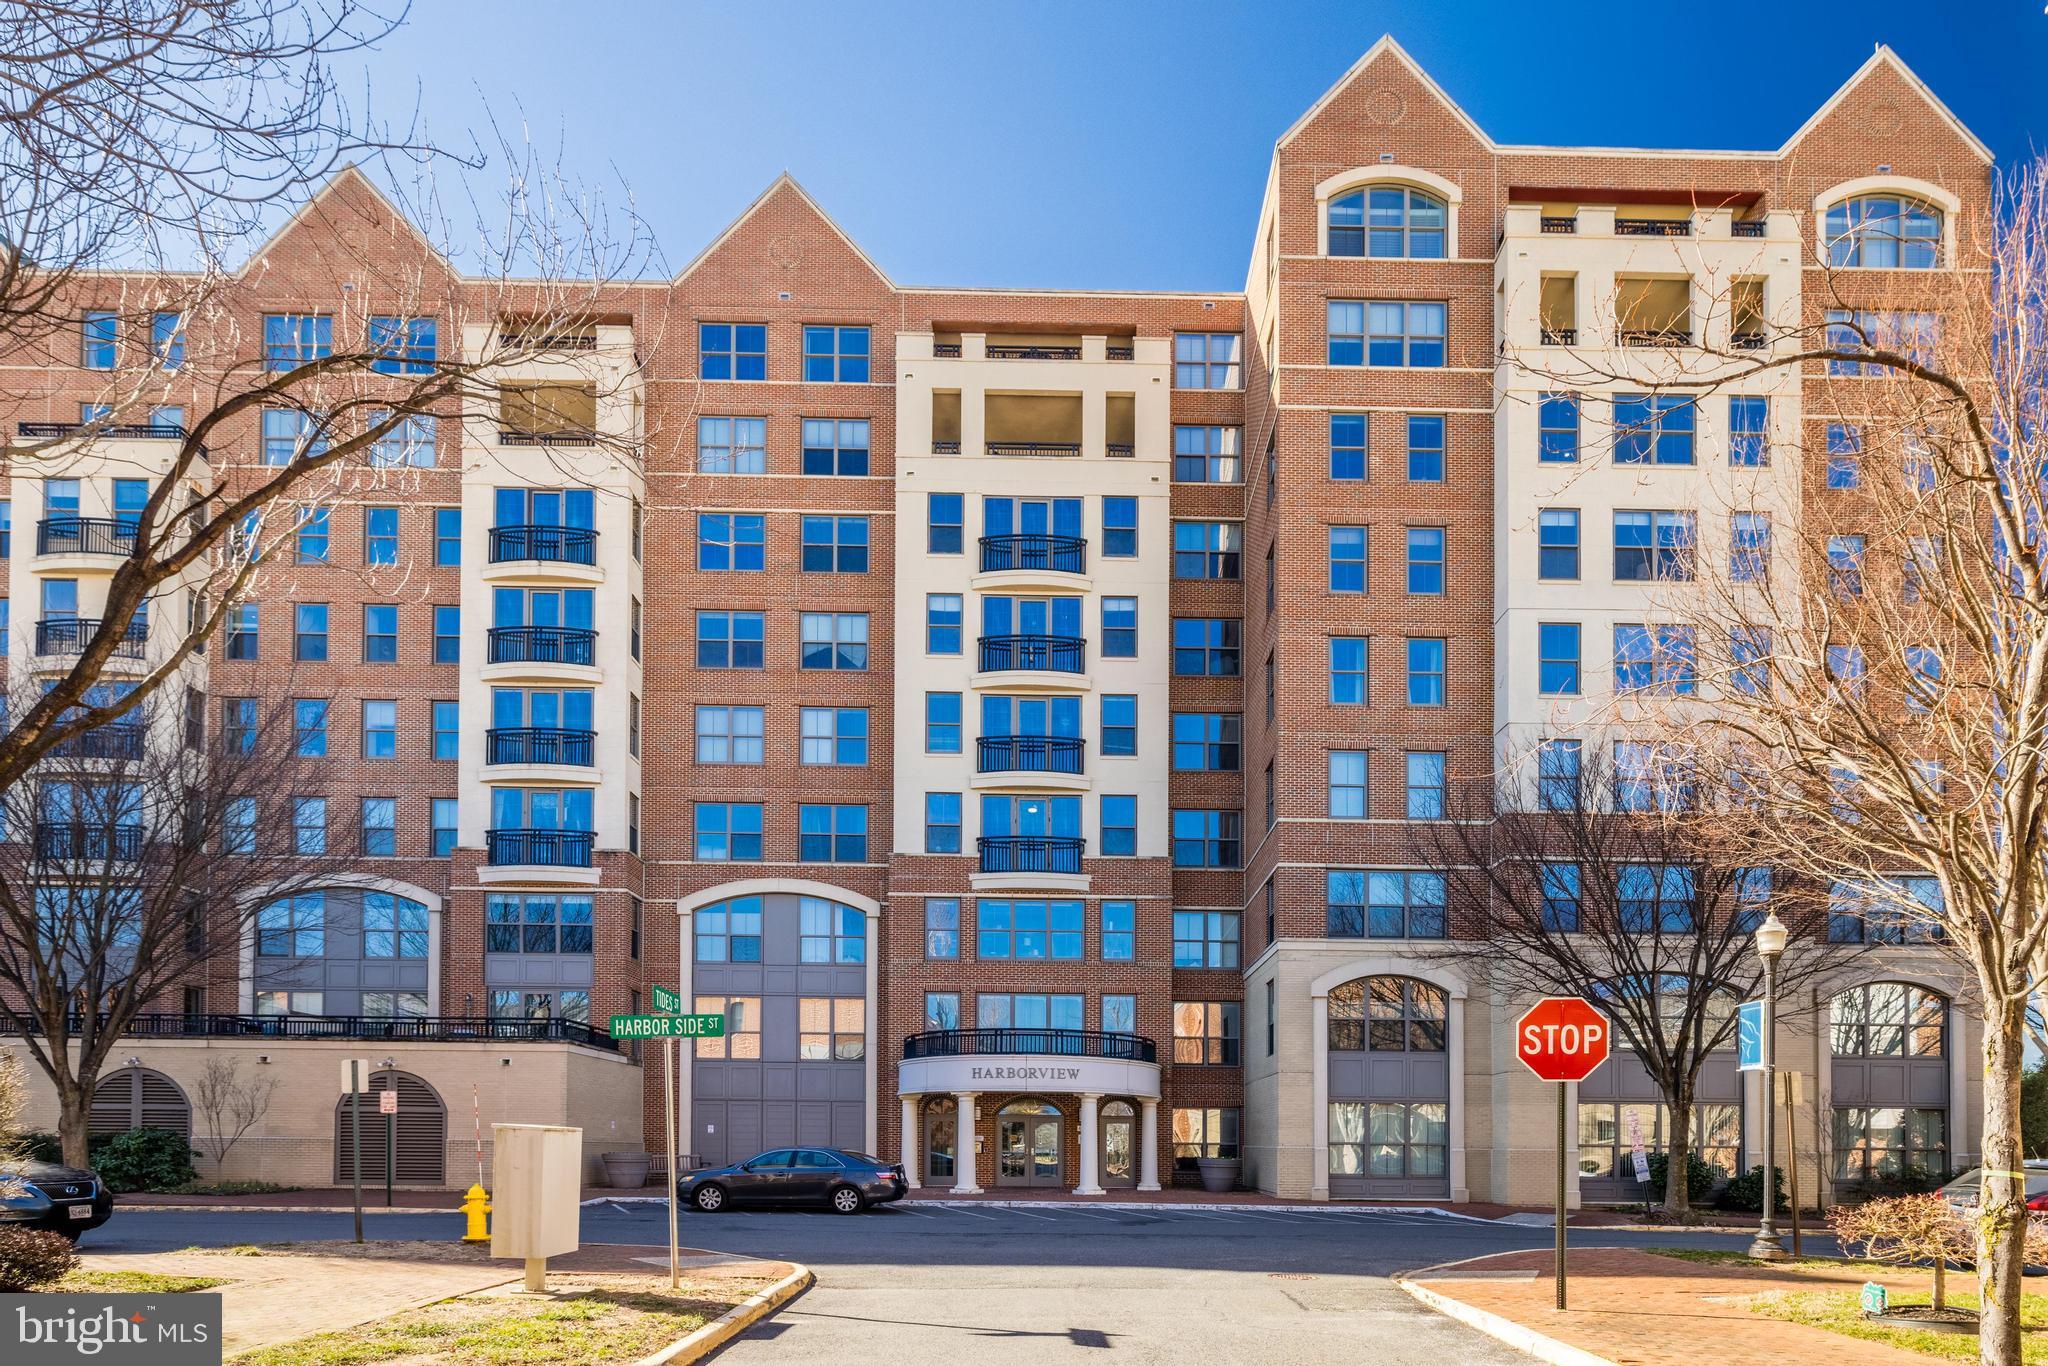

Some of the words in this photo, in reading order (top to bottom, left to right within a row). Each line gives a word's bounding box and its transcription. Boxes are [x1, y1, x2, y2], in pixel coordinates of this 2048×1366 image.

[655, 989, 673, 1012] TIDES
[673, 998, 679, 1010] ST
[615, 1018, 670, 1036] HARBOR
[675, 1018, 705, 1035] SIDE
[708, 1017, 719, 1029] ST
[1523, 1024, 1603, 1055] STOP
[972, 1067, 1081, 1080] HARBORVIEW
